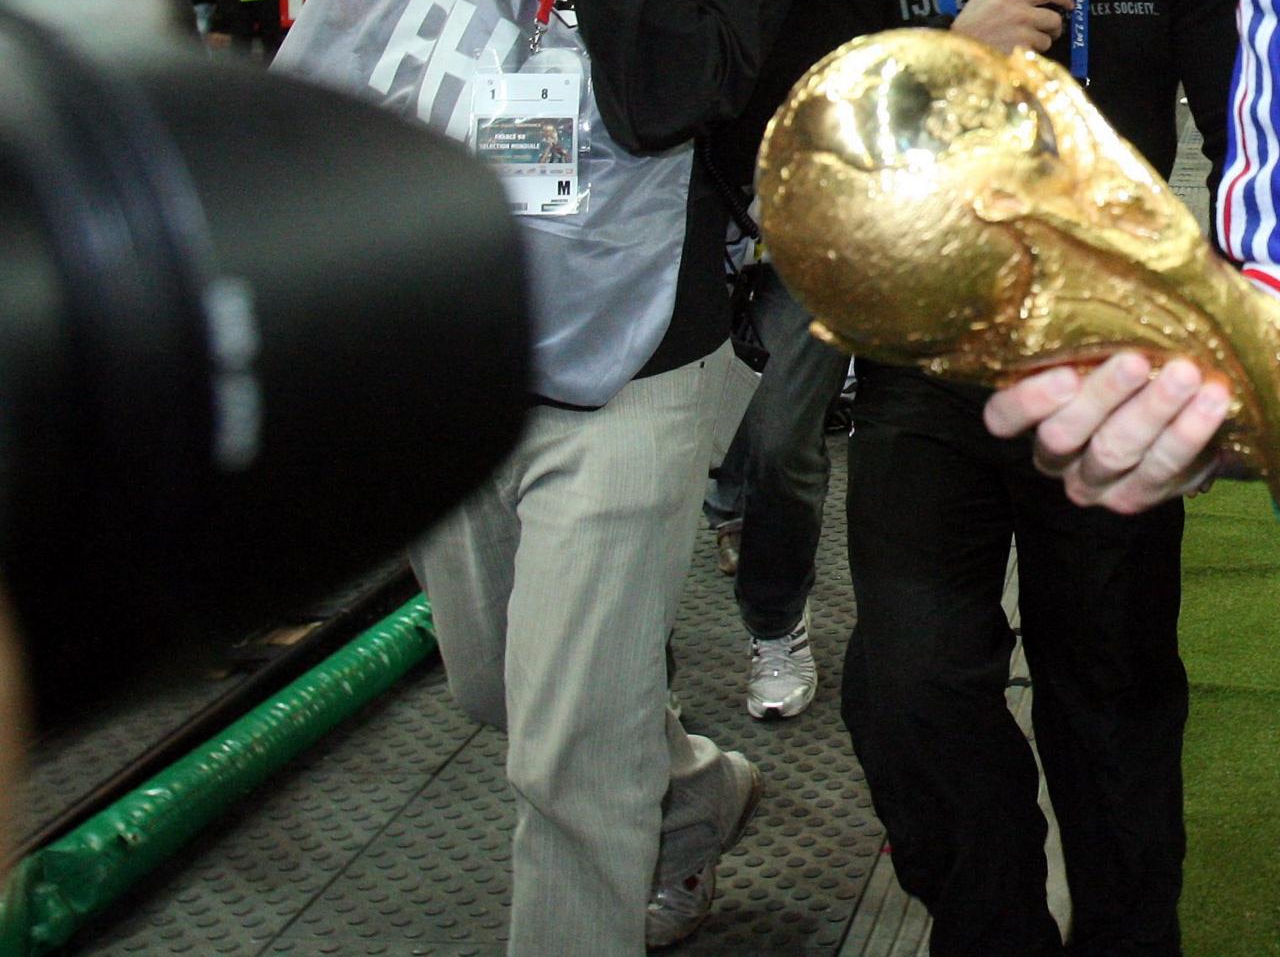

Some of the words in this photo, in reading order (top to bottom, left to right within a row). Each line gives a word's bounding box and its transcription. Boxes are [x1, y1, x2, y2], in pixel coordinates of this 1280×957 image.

[1091, 4, 1111, 17] LEX
[541, 88, 548, 100] 8
[557, 180, 571, 195] M
